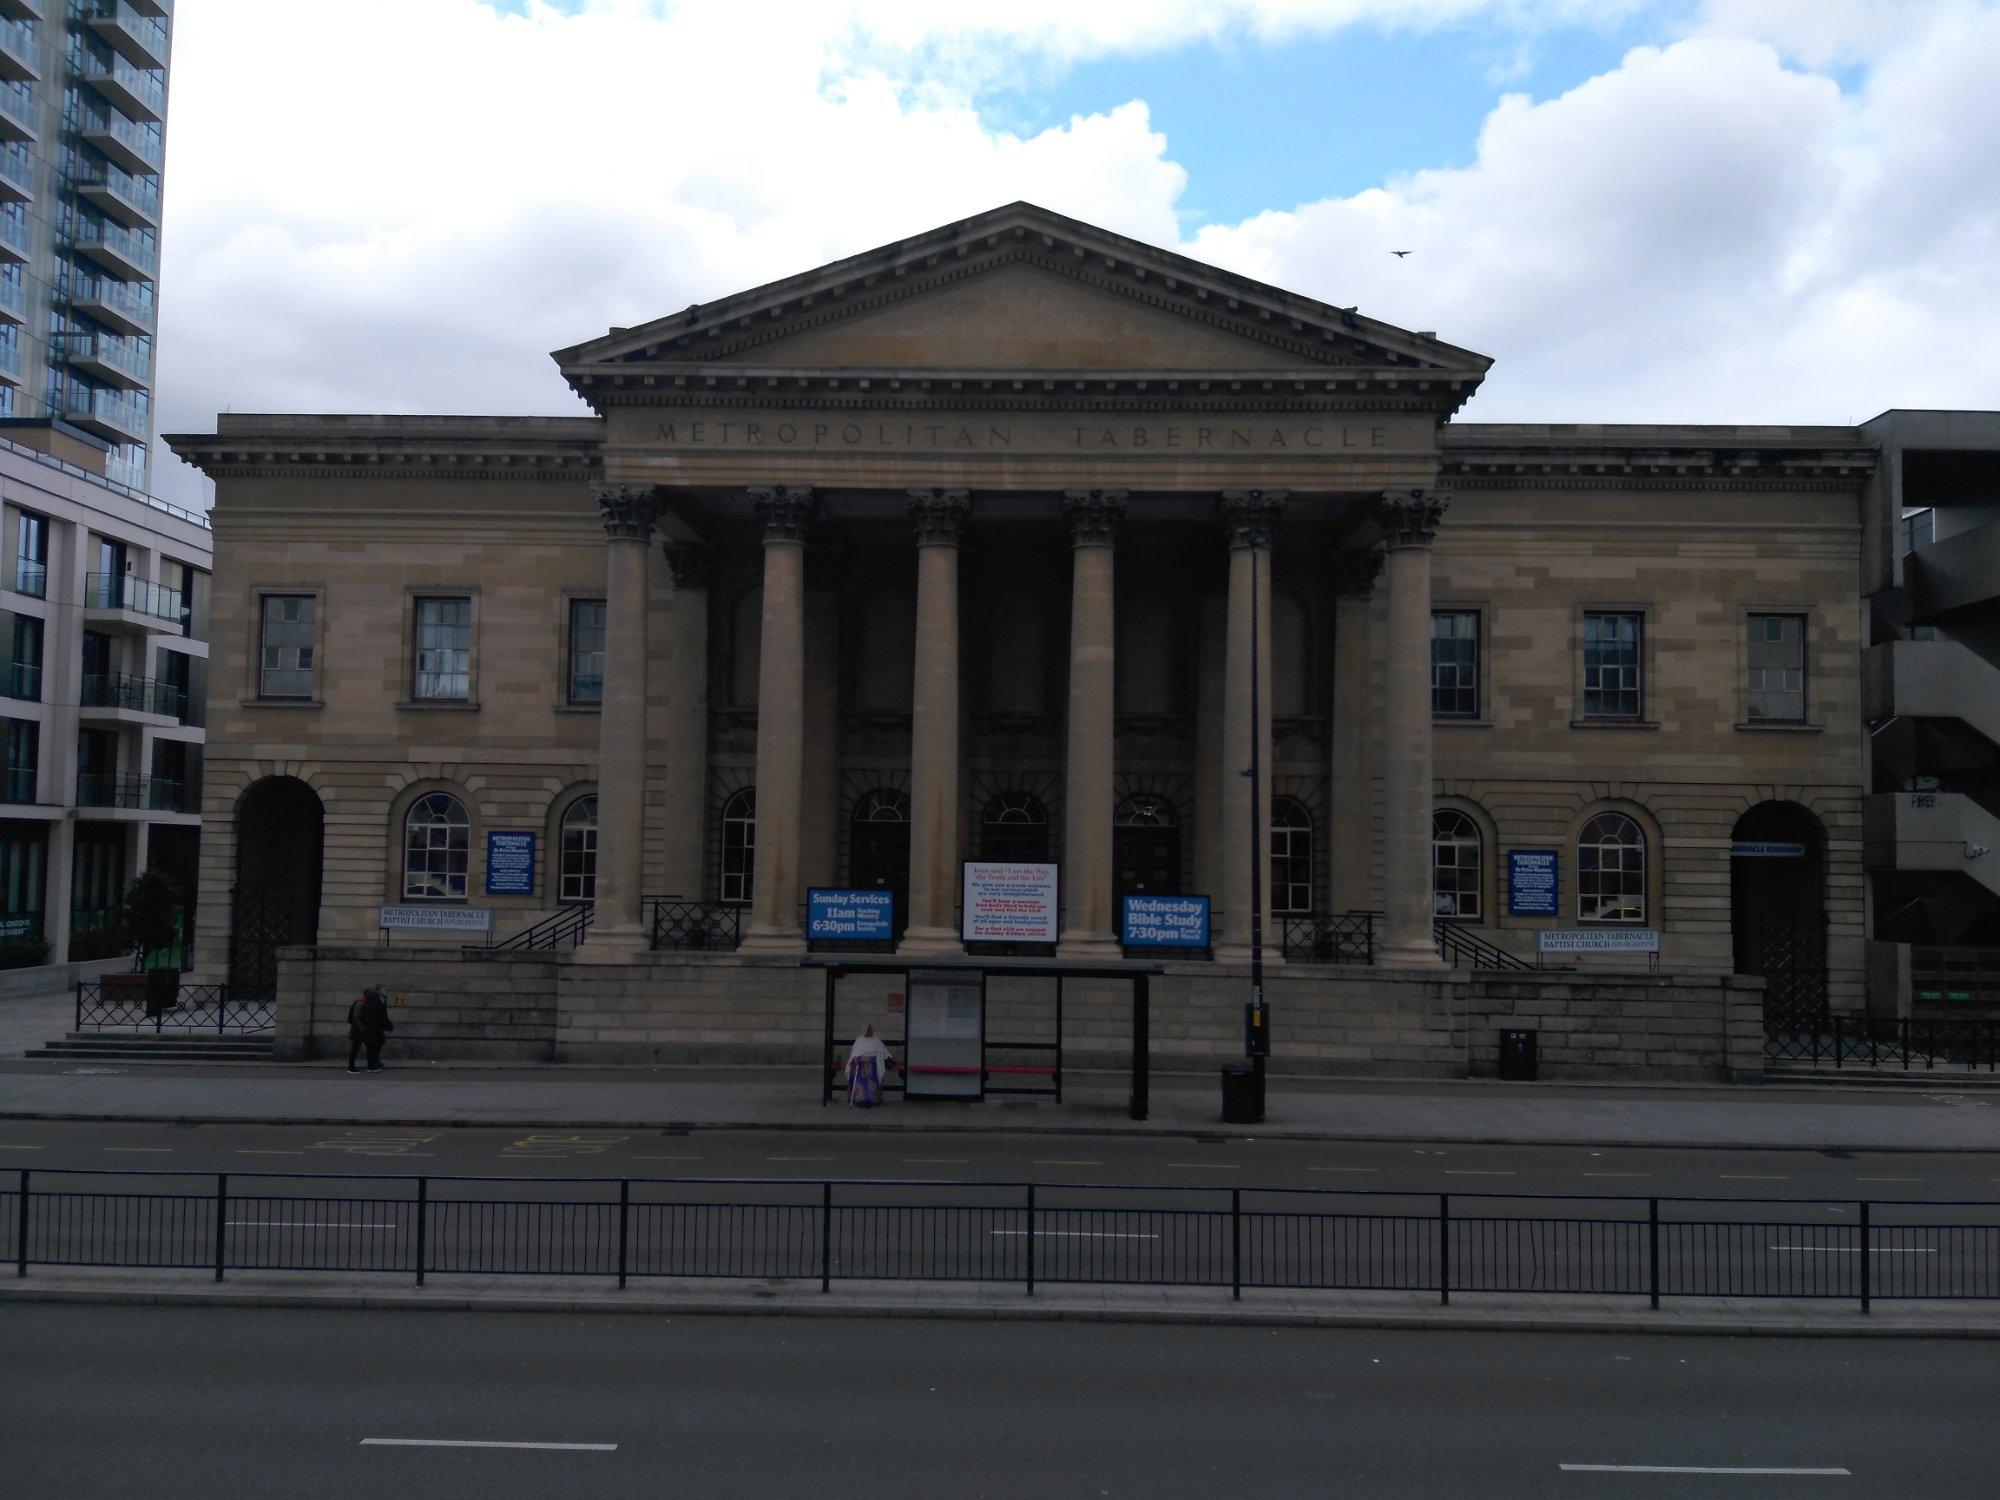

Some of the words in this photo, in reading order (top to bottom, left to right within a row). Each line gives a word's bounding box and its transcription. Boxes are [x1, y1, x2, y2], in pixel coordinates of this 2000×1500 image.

[658, 422, 1012, 445] METROPOLITAN
[1070, 427, 1386, 447] TABERNACLE
[813, 893, 848, 906] Sunday
[850, 893, 890, 904] Services
[827, 907, 855, 918] 11am
[1128, 899, 1202, 915] Wednesday
[383, 909, 438, 917] METROPOLITAN
[440, 911, 484, 919] TABERNACLE
[412, 917, 443, 925] CHURCH
[1128, 913, 1162, 925] Bible
[1164, 913, 1202, 929] Study
